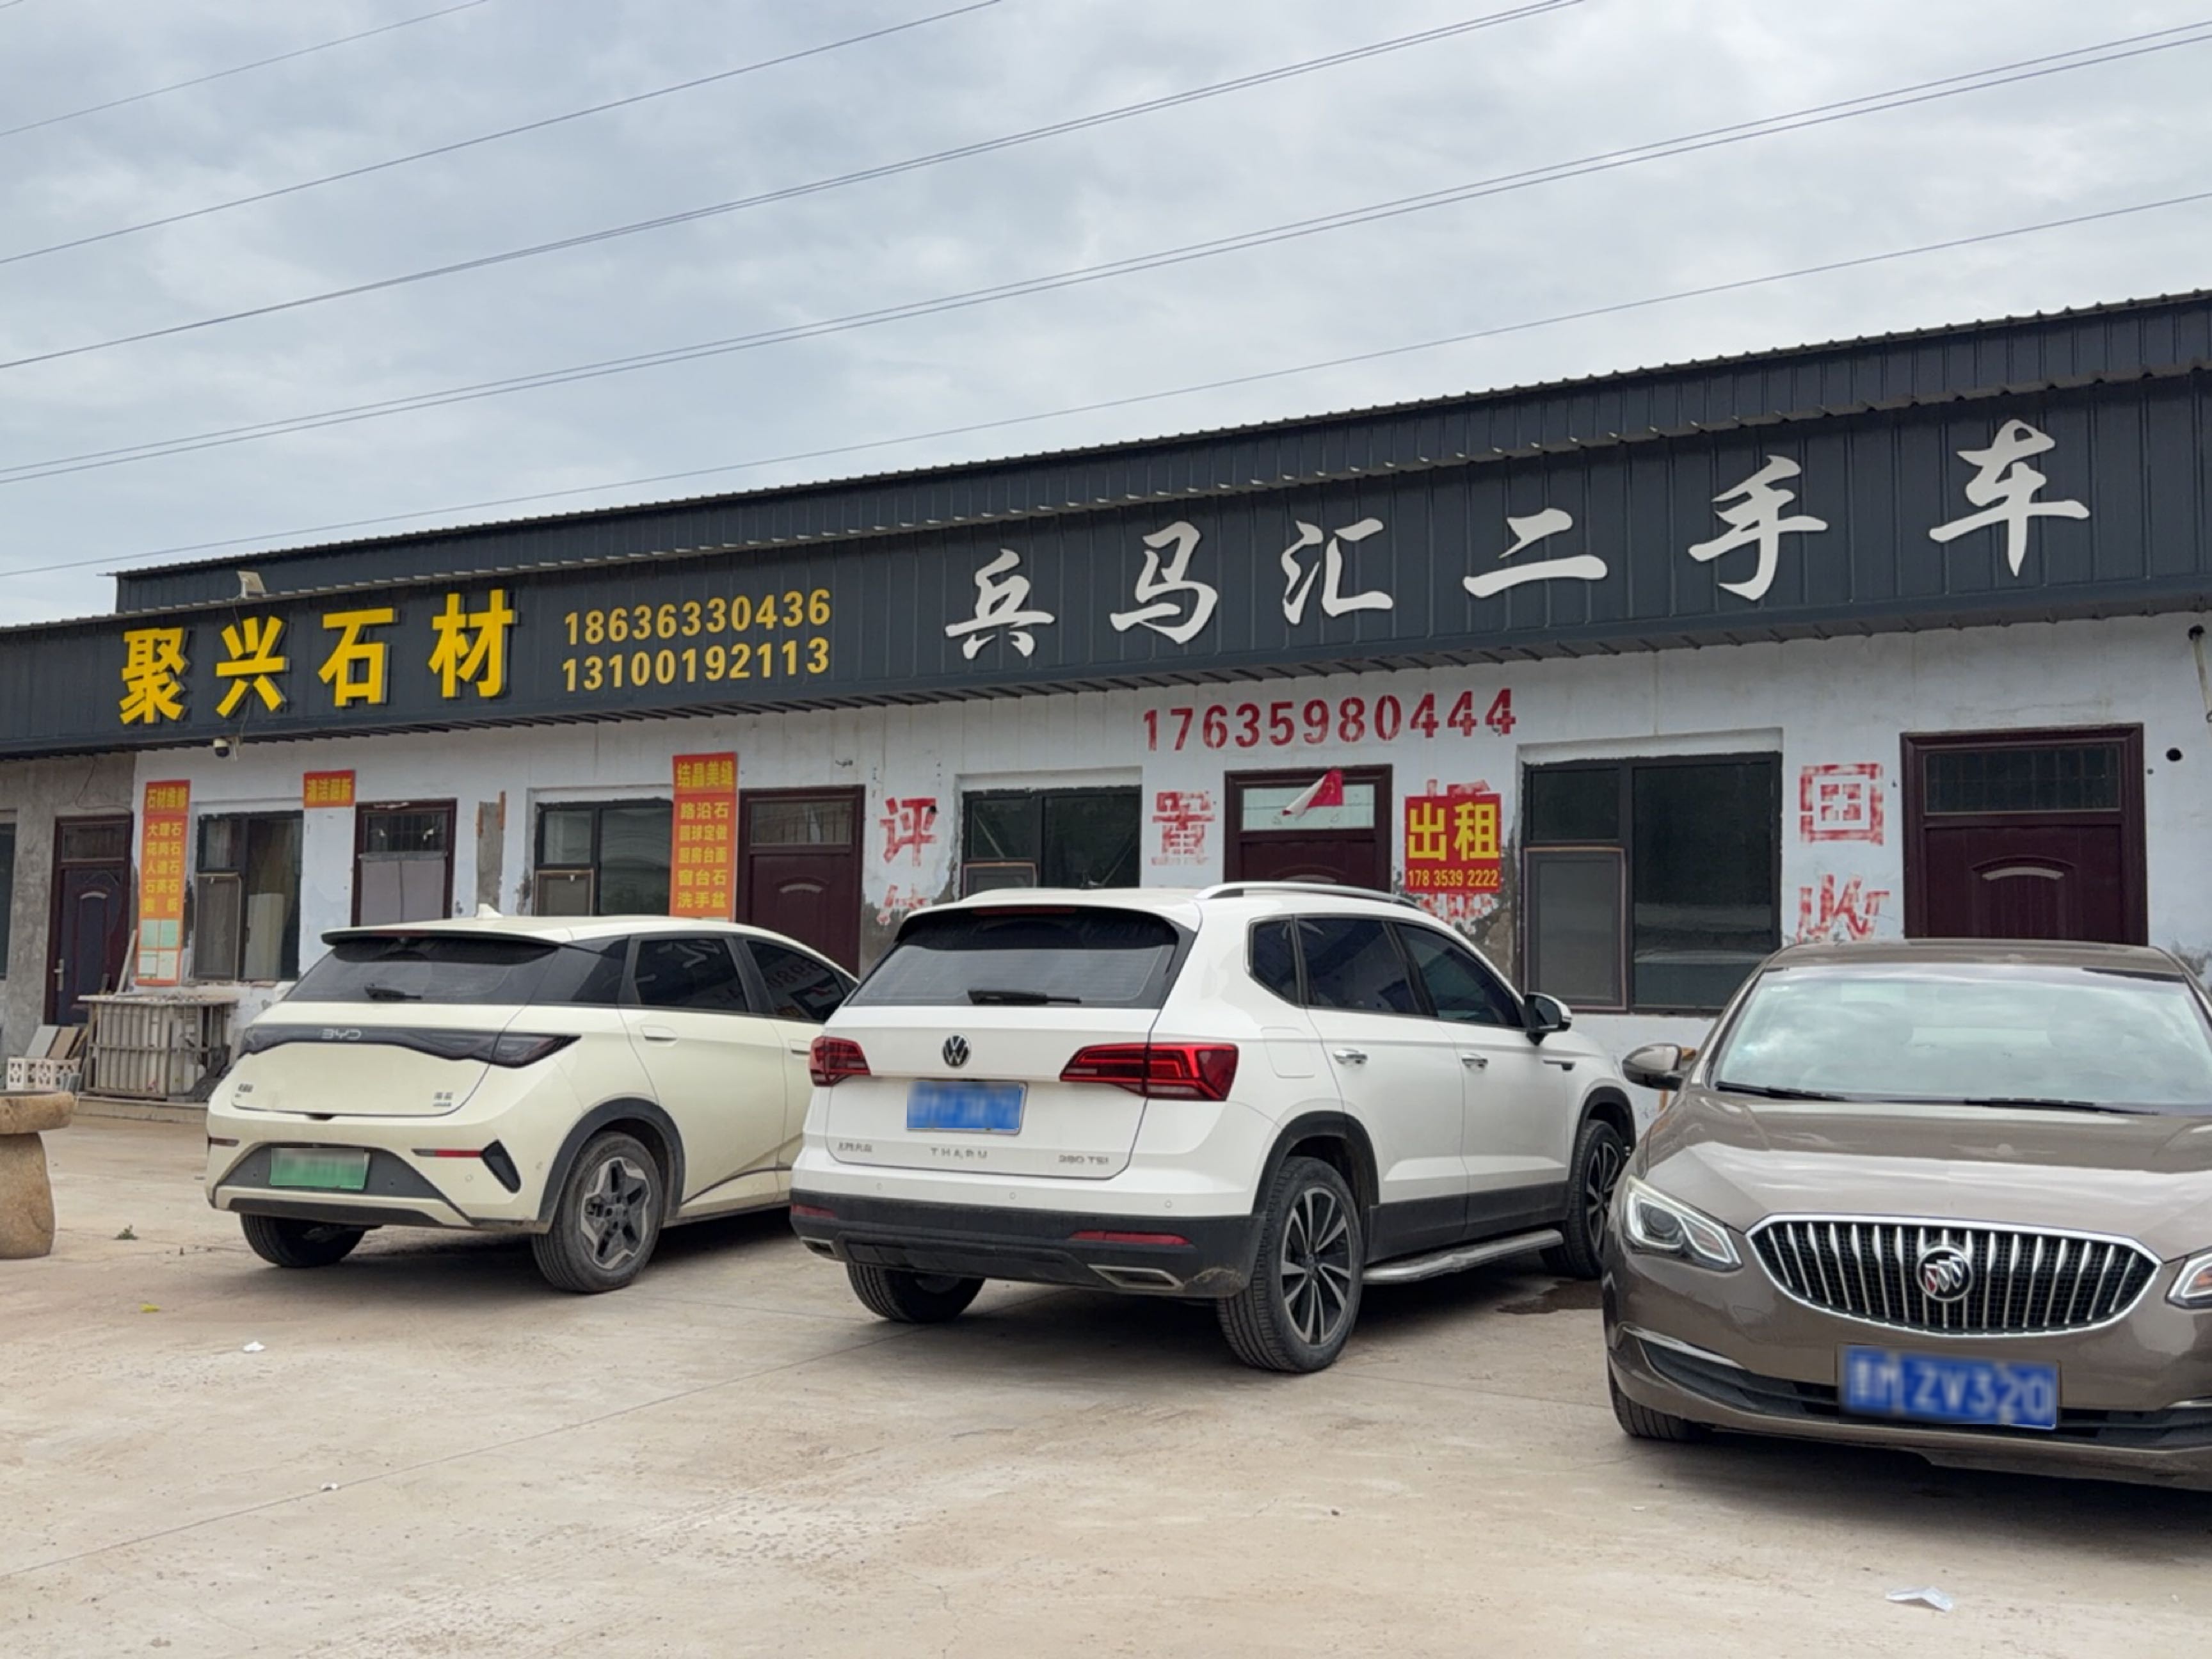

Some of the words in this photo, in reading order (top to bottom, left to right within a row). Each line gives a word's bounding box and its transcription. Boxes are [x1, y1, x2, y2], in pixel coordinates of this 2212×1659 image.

[945, 420, 2090, 661] 兵马汇二手车
[565, 588, 831, 646] 18636330436
[120, 589, 515, 725] 聚兴石材
[562, 637, 830, 692] 13100192113
[1143, 687, 1517, 751] 17635980444
[680, 801, 730, 820] 路沿石
[147, 821, 184, 837] 大理石
[1408, 801, 1500, 862] 出租
[678, 846, 728, 863] 厨房台面
[678, 869, 728, 886] 窗台石
[1409, 869, 1429, 886] 178
[1433, 869, 1464, 887] 3539
[1467, 869, 1499, 886] 2222
[677, 890, 726, 909] 洗手盆
[321, 1028, 362, 1040] BYD
